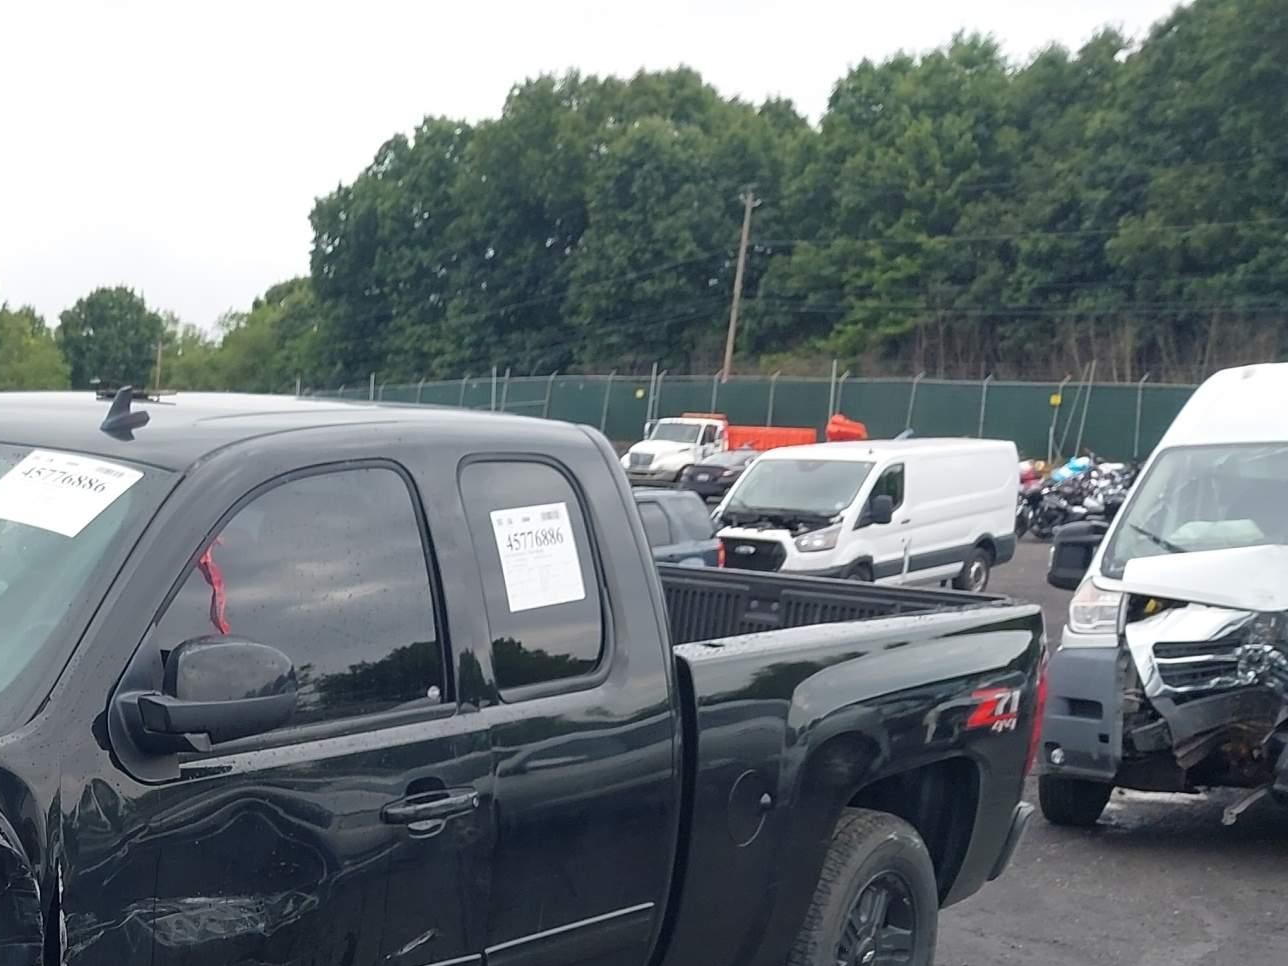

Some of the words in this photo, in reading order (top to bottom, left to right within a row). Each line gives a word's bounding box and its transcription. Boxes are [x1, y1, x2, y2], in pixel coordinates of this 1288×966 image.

[21, 466, 107, 493] 45776886
[505, 527, 564, 550] 45776886
[967, 687, 1021, 728] Z71
